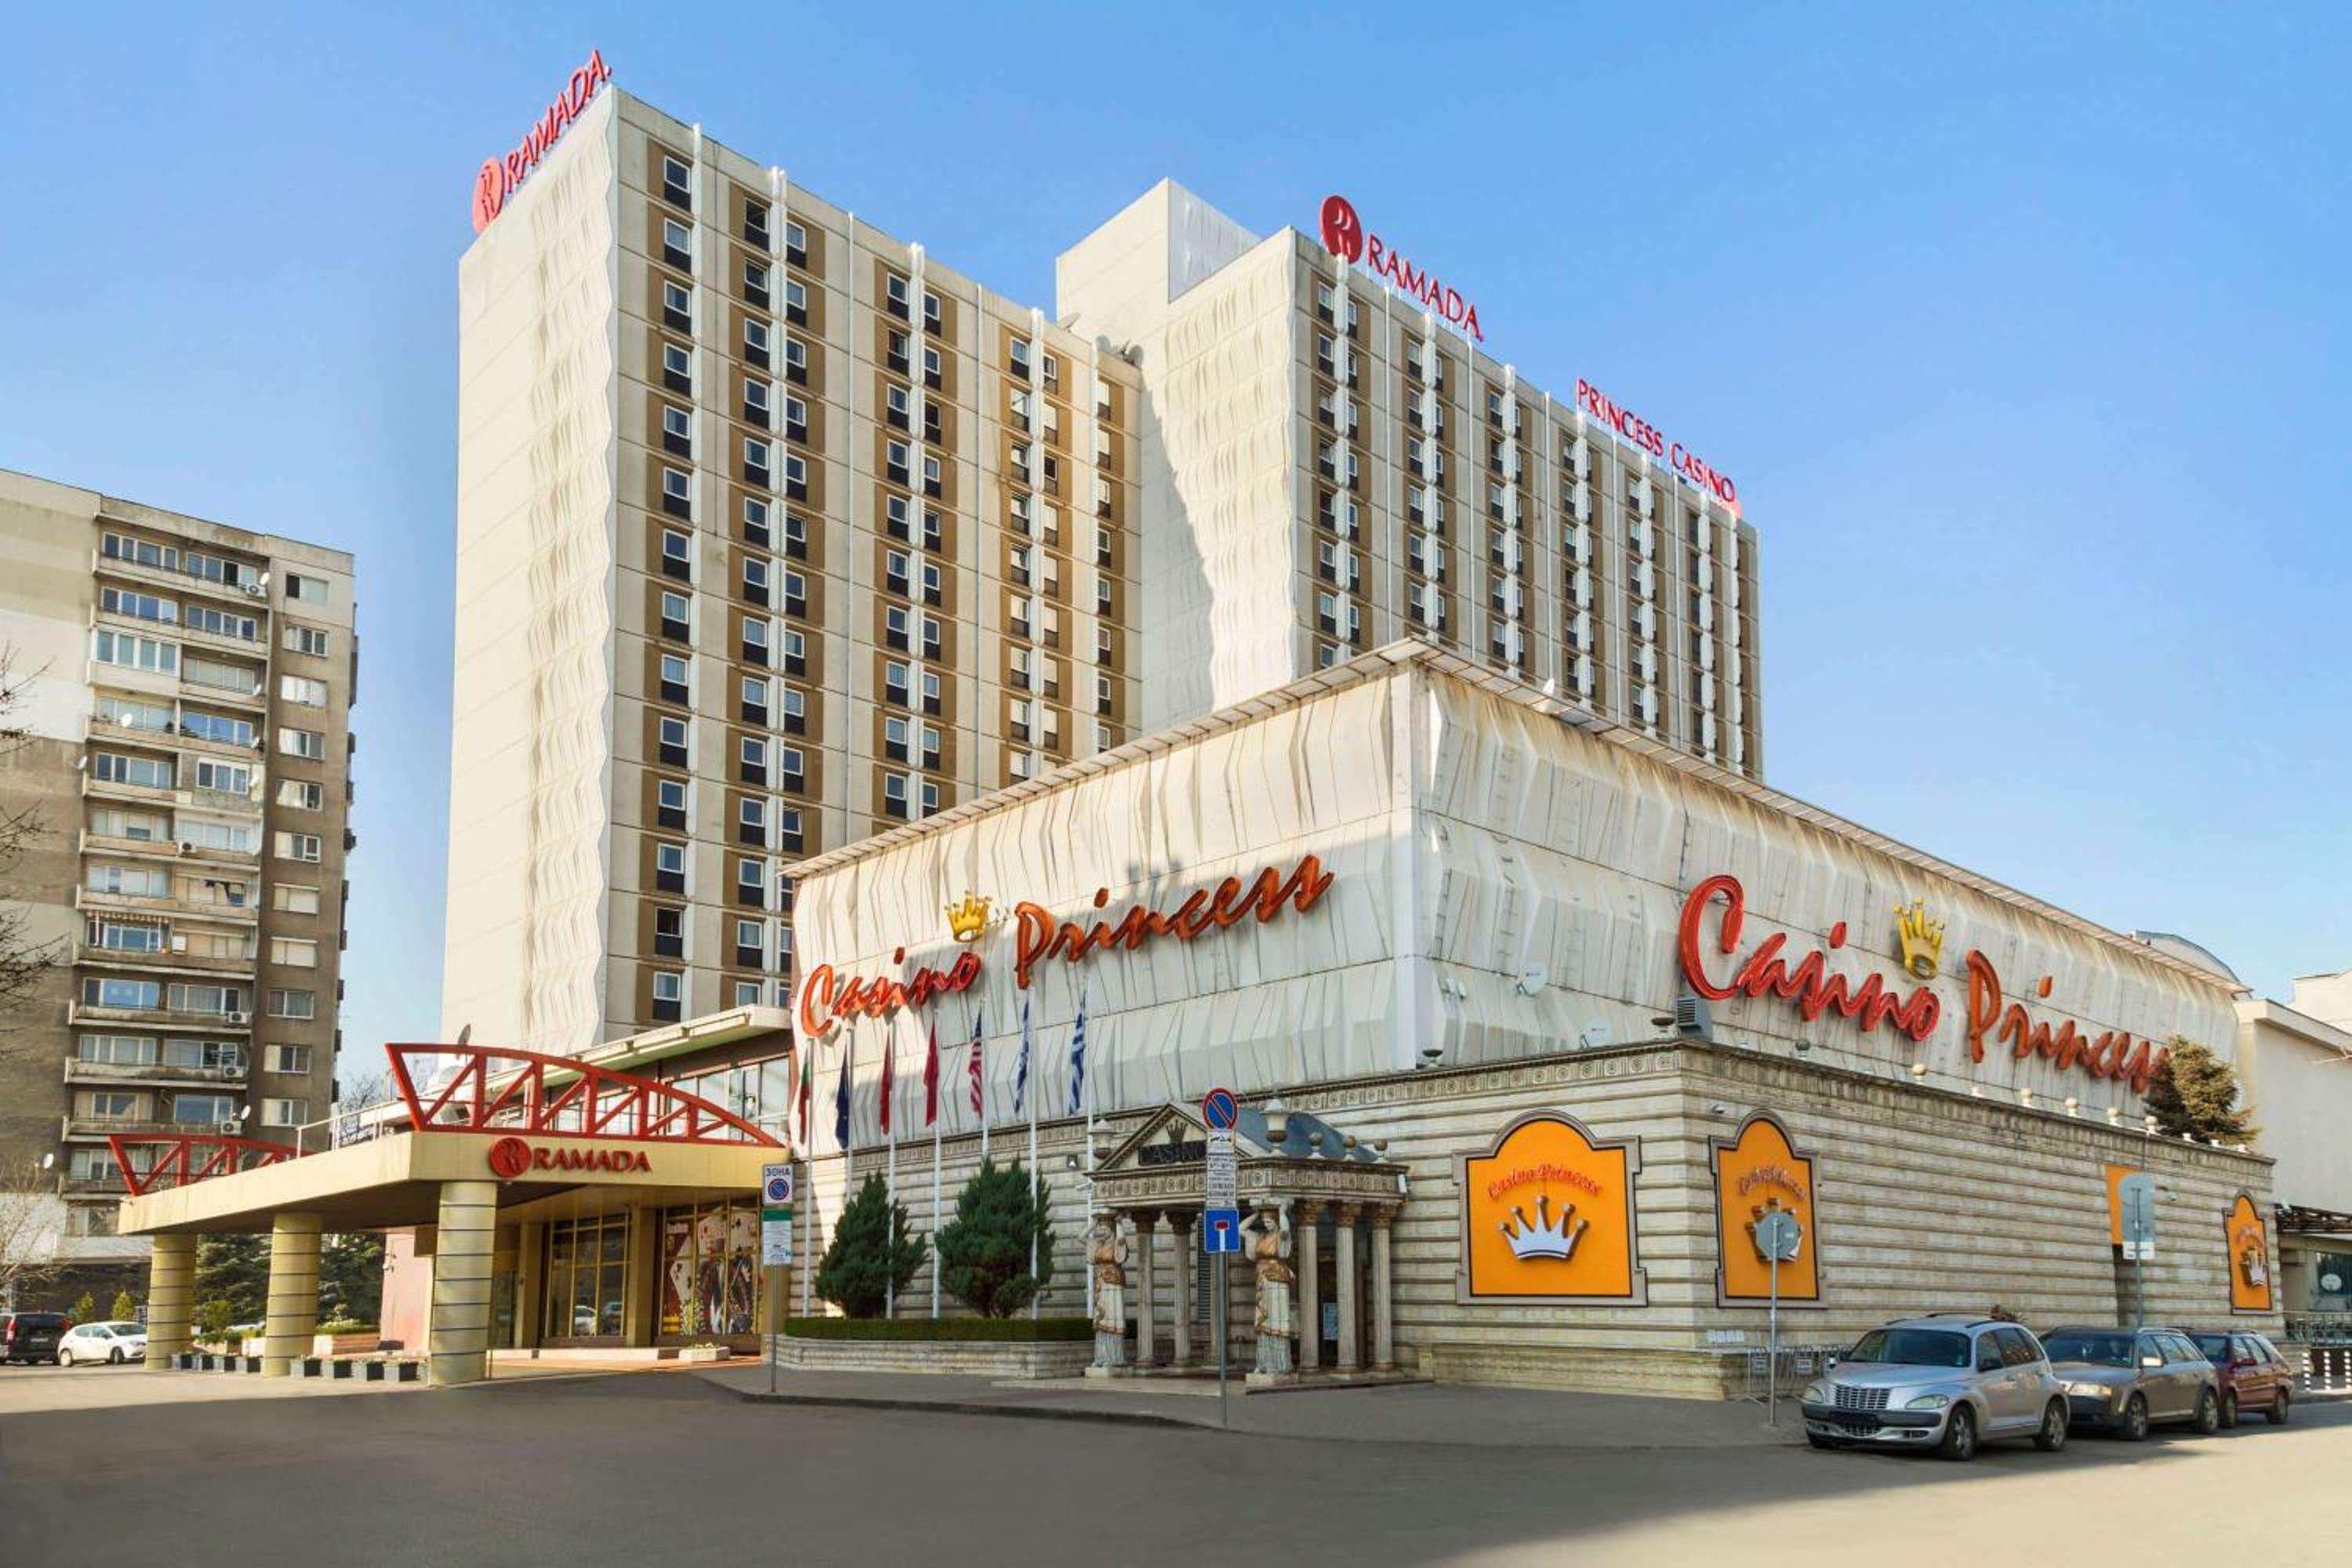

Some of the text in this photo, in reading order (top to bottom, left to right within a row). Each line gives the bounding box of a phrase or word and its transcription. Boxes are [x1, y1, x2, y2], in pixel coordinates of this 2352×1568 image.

[504, 49, 606, 194] RAMADA
[1367, 233, 1482, 341] RAMADA
[1576, 376, 1737, 503] PRINCESS CASINO
[800, 854, 1335, 1038] Casino Princess
[1679, 874, 1941, 1042] Casino
[532, 1146, 652, 1173] RAMADA
